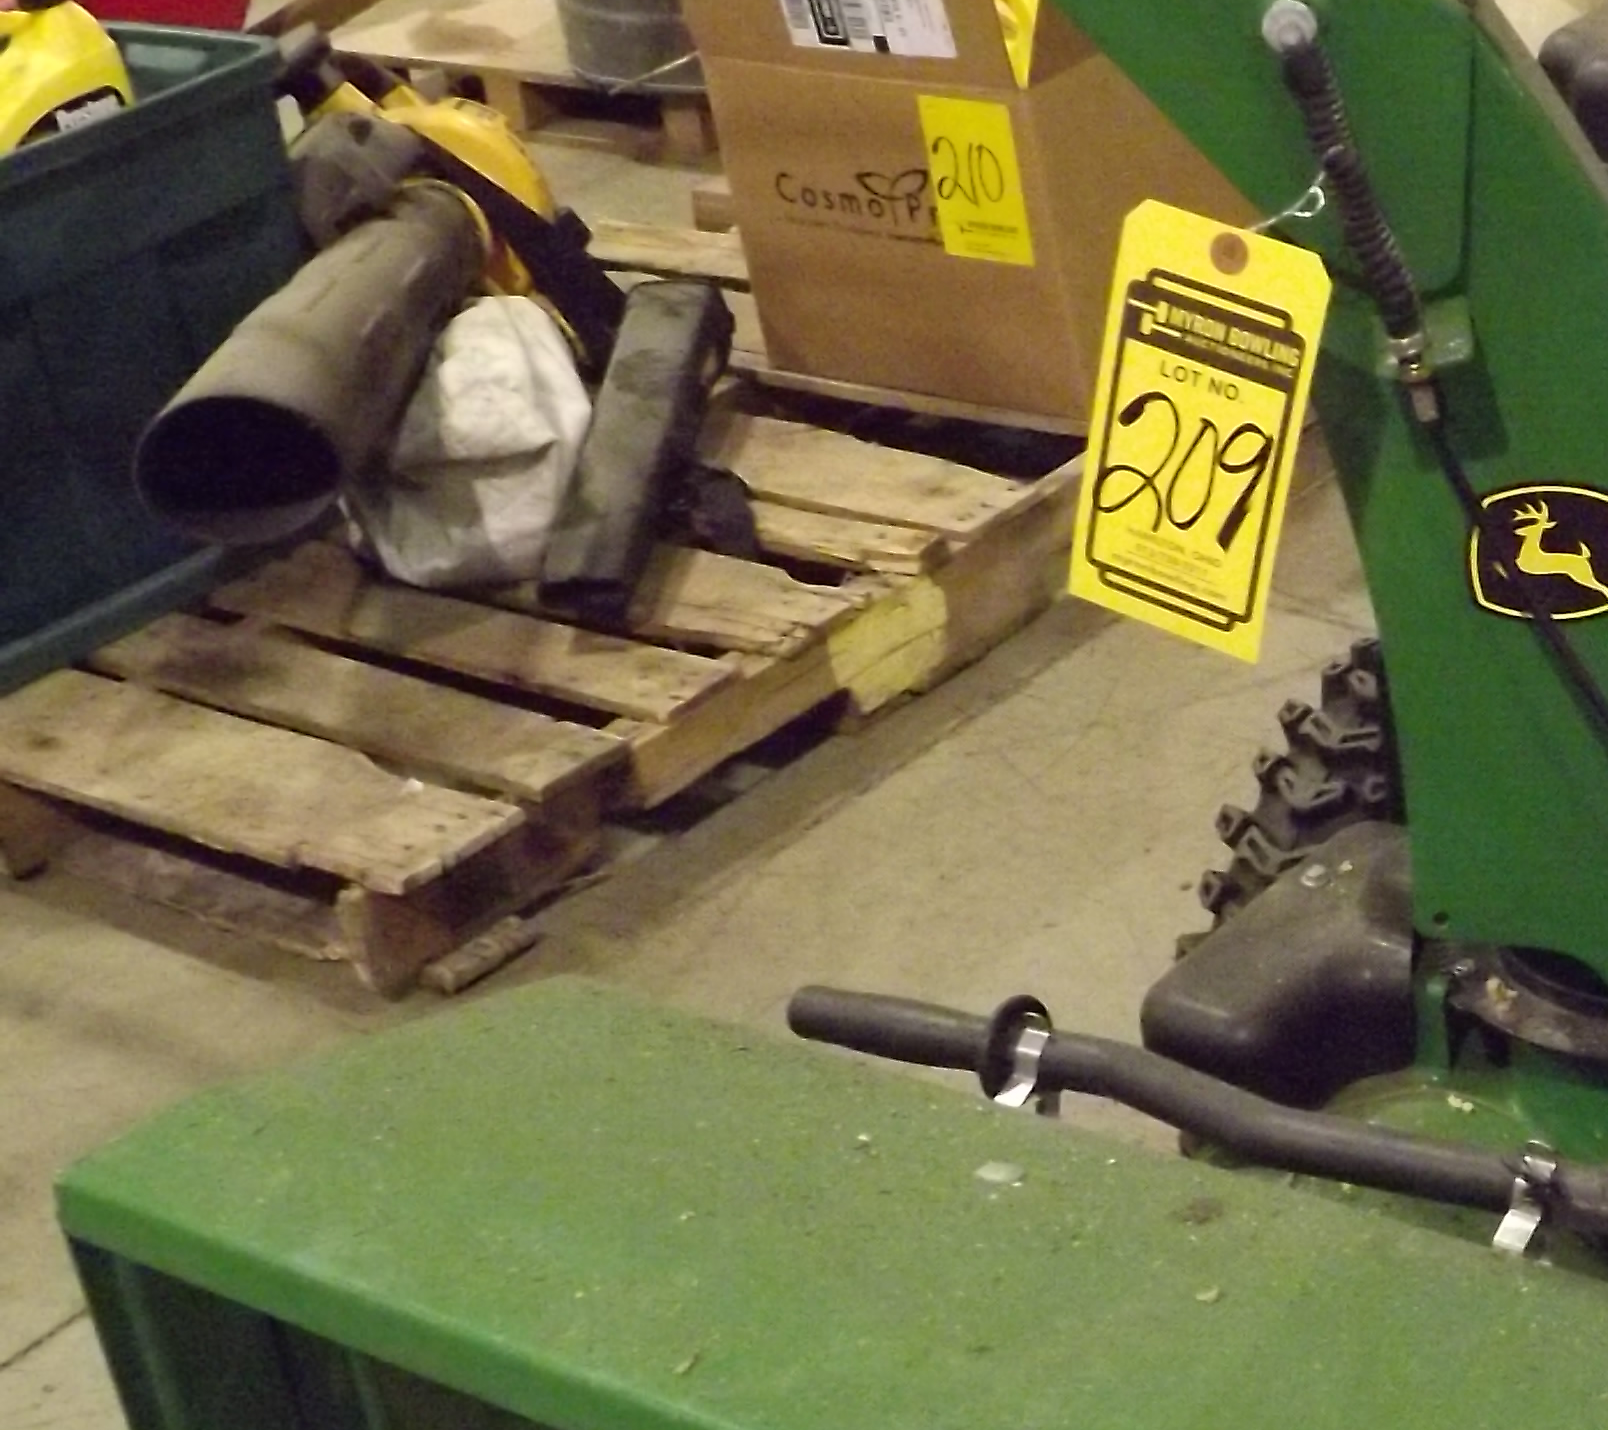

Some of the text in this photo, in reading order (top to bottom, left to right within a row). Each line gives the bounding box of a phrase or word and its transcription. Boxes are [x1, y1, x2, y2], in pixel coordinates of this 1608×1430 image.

[931, 136, 1004, 209] 210
[1169, 306, 1228, 342] MYRON
[1228, 325, 1300, 368] BOWLING
[1160, 359, 1202, 387] LOT
[1092, 390, 1275, 554] 209
